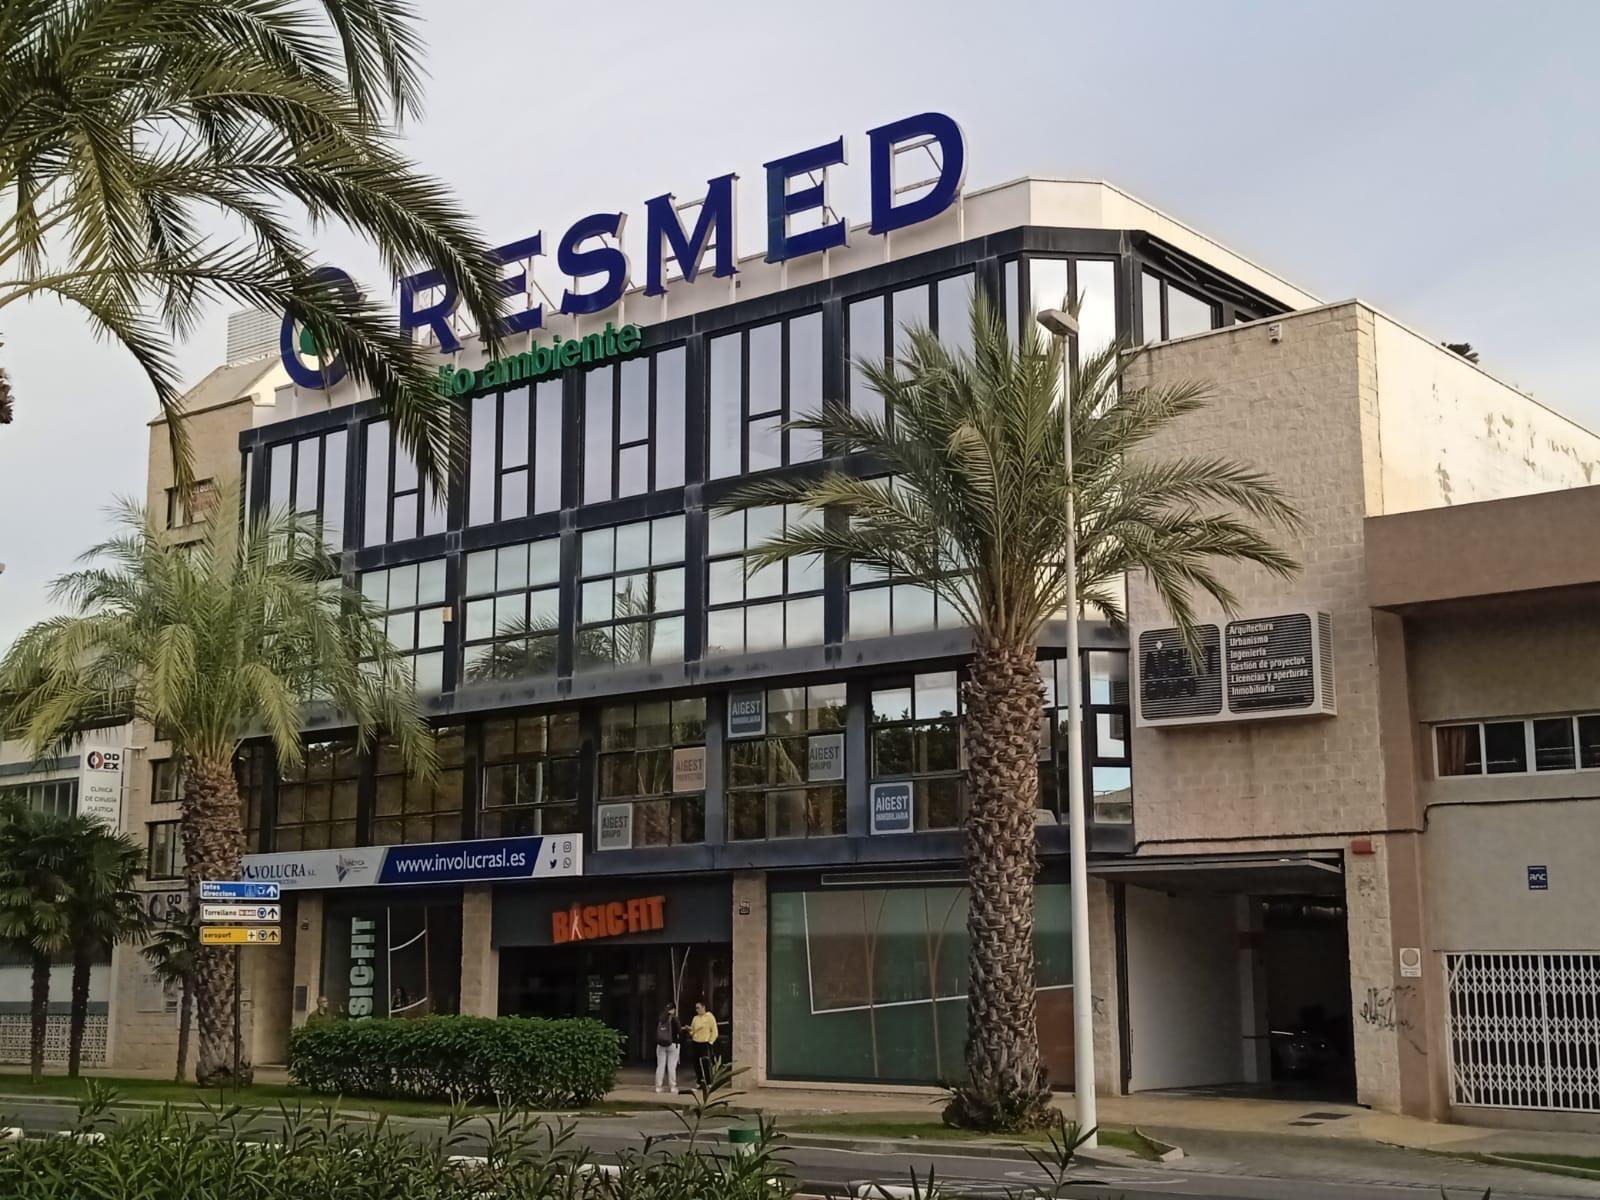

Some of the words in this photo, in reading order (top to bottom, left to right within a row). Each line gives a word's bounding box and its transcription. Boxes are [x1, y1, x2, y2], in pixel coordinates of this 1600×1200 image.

[482, 321, 642, 389] ambiente
[1229, 623, 1274, 636] Arquitectura
[1229, 635, 1269, 647] Urbanismo
[1230, 660, 1257, 672] Gestión
[1259, 659, 1268, 669] de
[1269, 656, 1306, 670] proyectos
[1231, 672, 1266, 683] Licencias
[1266, 672, 1272, 682] y
[1273, 669, 1309, 681] aperturas
[1231, 684, 1275, 696] Inmobiliaria
[396, 848, 526, 873] www.involucrasl.es
